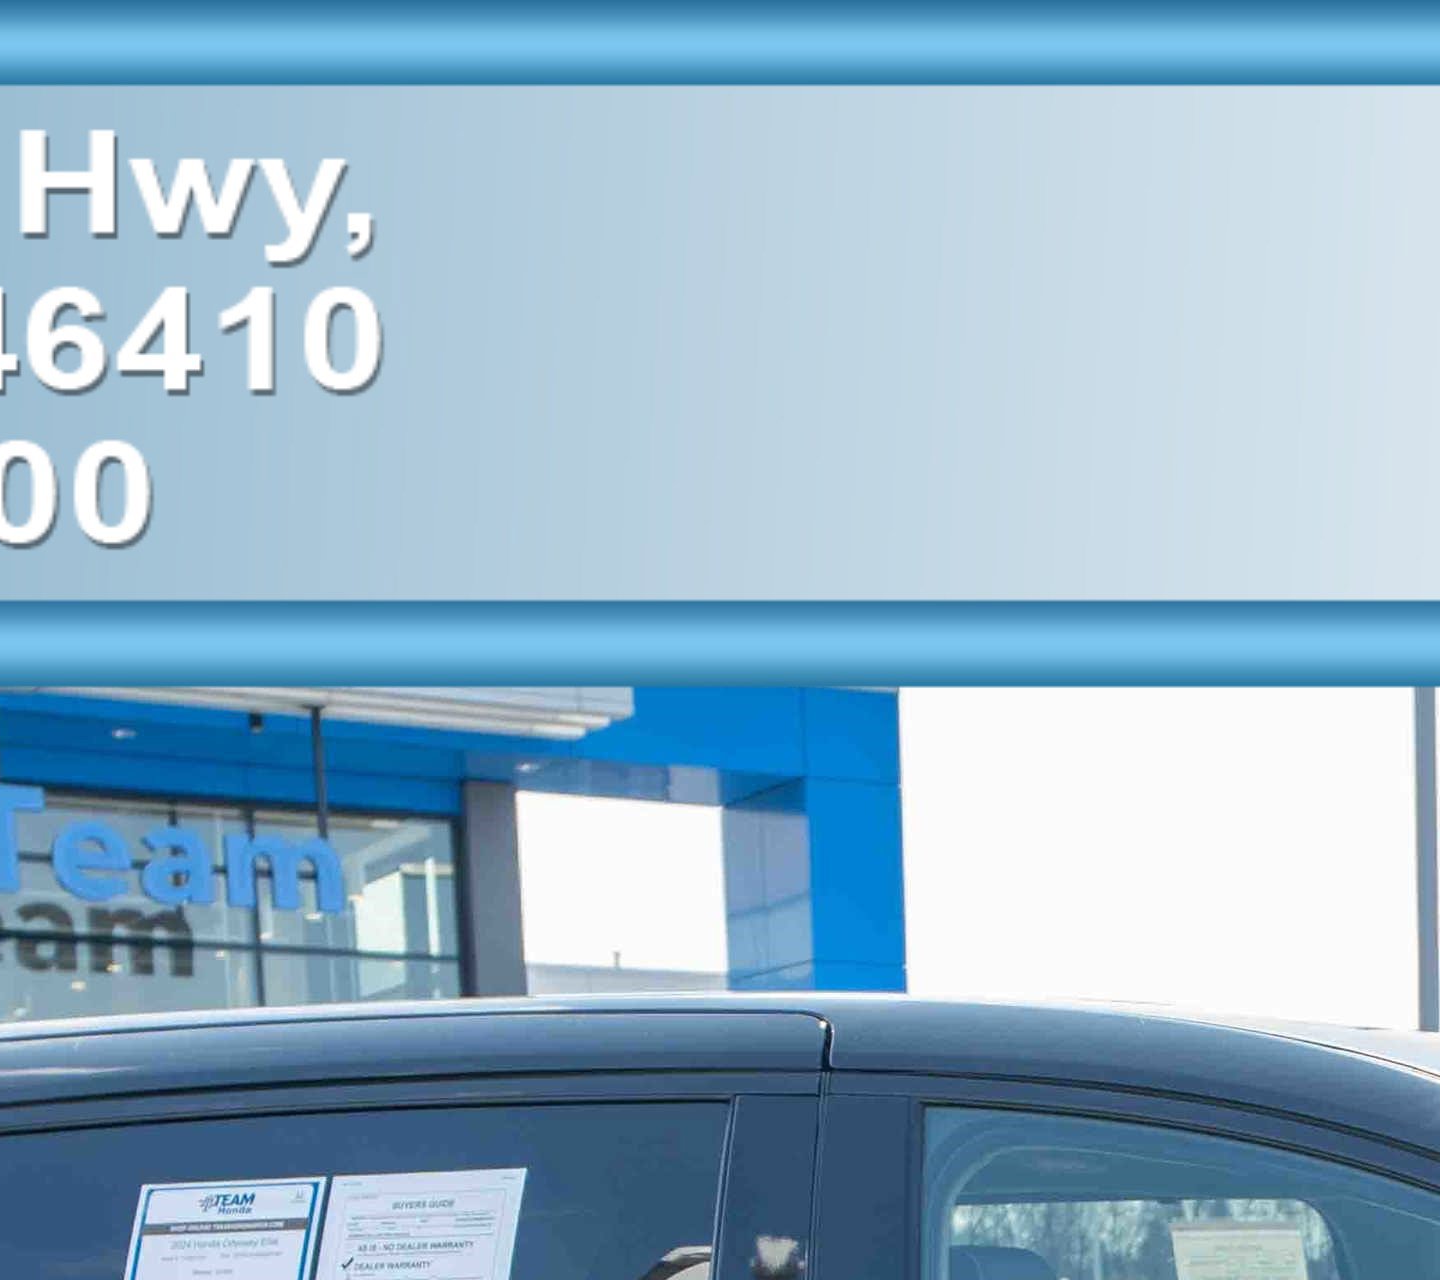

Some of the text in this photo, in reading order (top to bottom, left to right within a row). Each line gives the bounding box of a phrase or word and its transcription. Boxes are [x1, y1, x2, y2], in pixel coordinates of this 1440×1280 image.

[214, 1191, 257, 1206] TEAM
[392, 1199, 457, 1210] BUYERS GUIDE
[217, 1206, 253, 1215] Honda
[194, 1239, 221, 1249] Honda
[396, 1242, 429, 1251] DEALER
[430, 1241, 475, 1250] WARRANTY
[354, 1261, 432, 1271] DEALER WARRANTY
